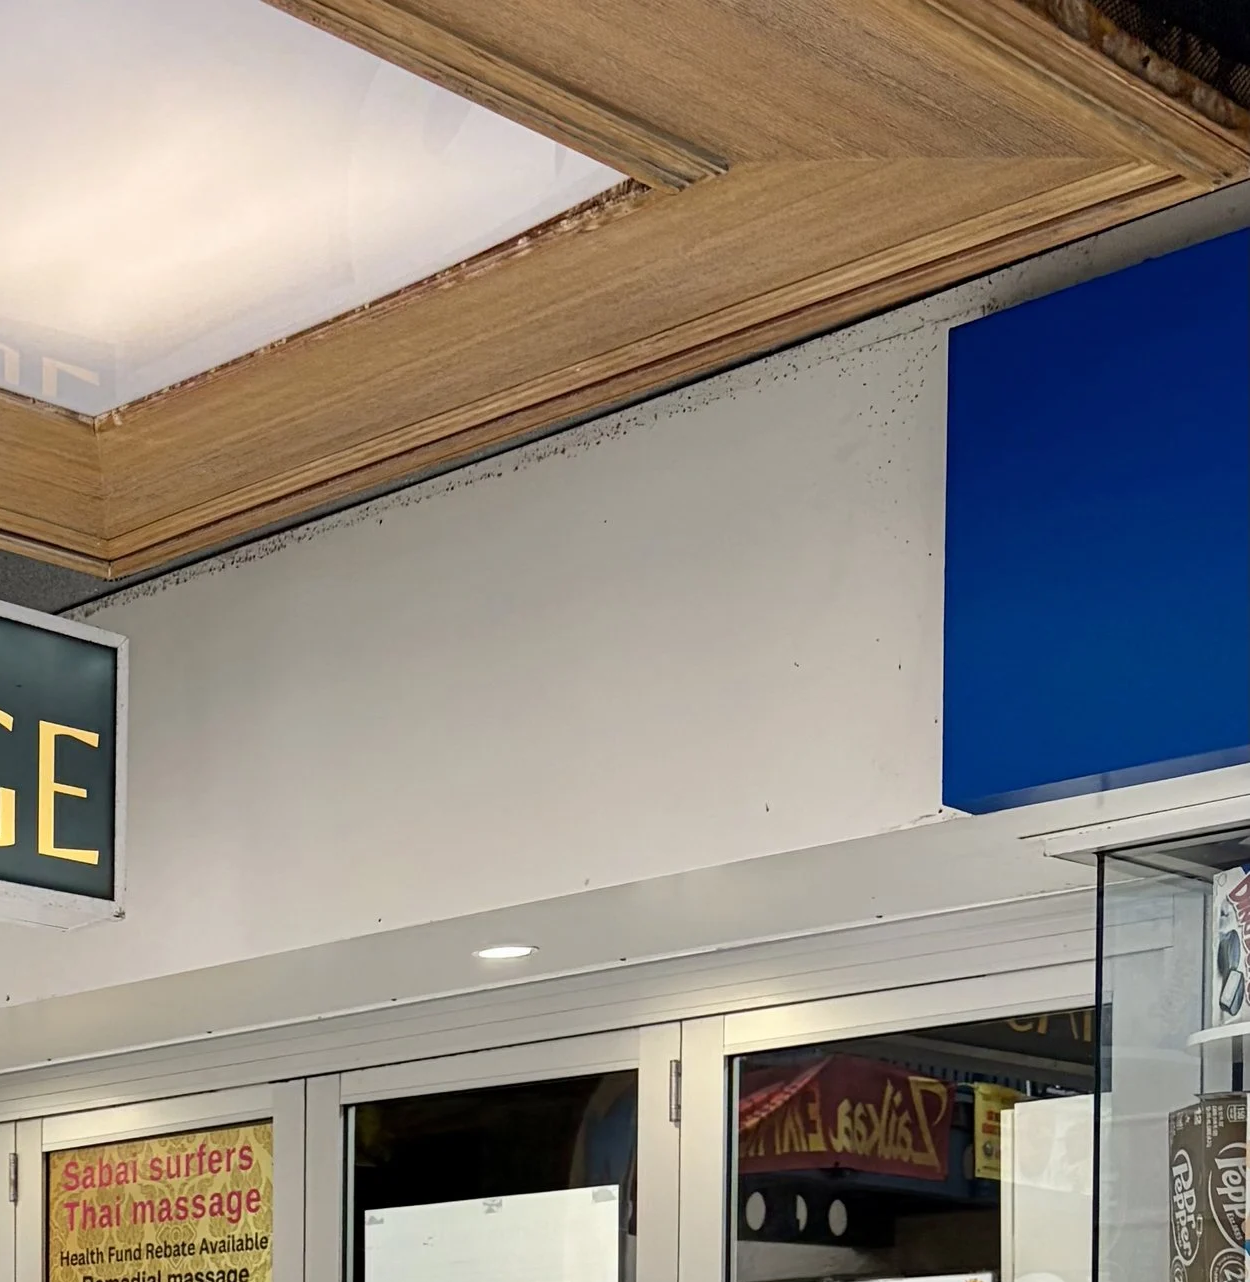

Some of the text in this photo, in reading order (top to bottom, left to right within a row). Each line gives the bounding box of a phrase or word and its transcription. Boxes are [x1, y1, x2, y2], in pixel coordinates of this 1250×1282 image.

[62, 1143, 254, 1191] Sabai surfers
[63, 1187, 261, 1231] Thai massage
[60, 1232, 268, 1267] Health Fund Rebate Available
